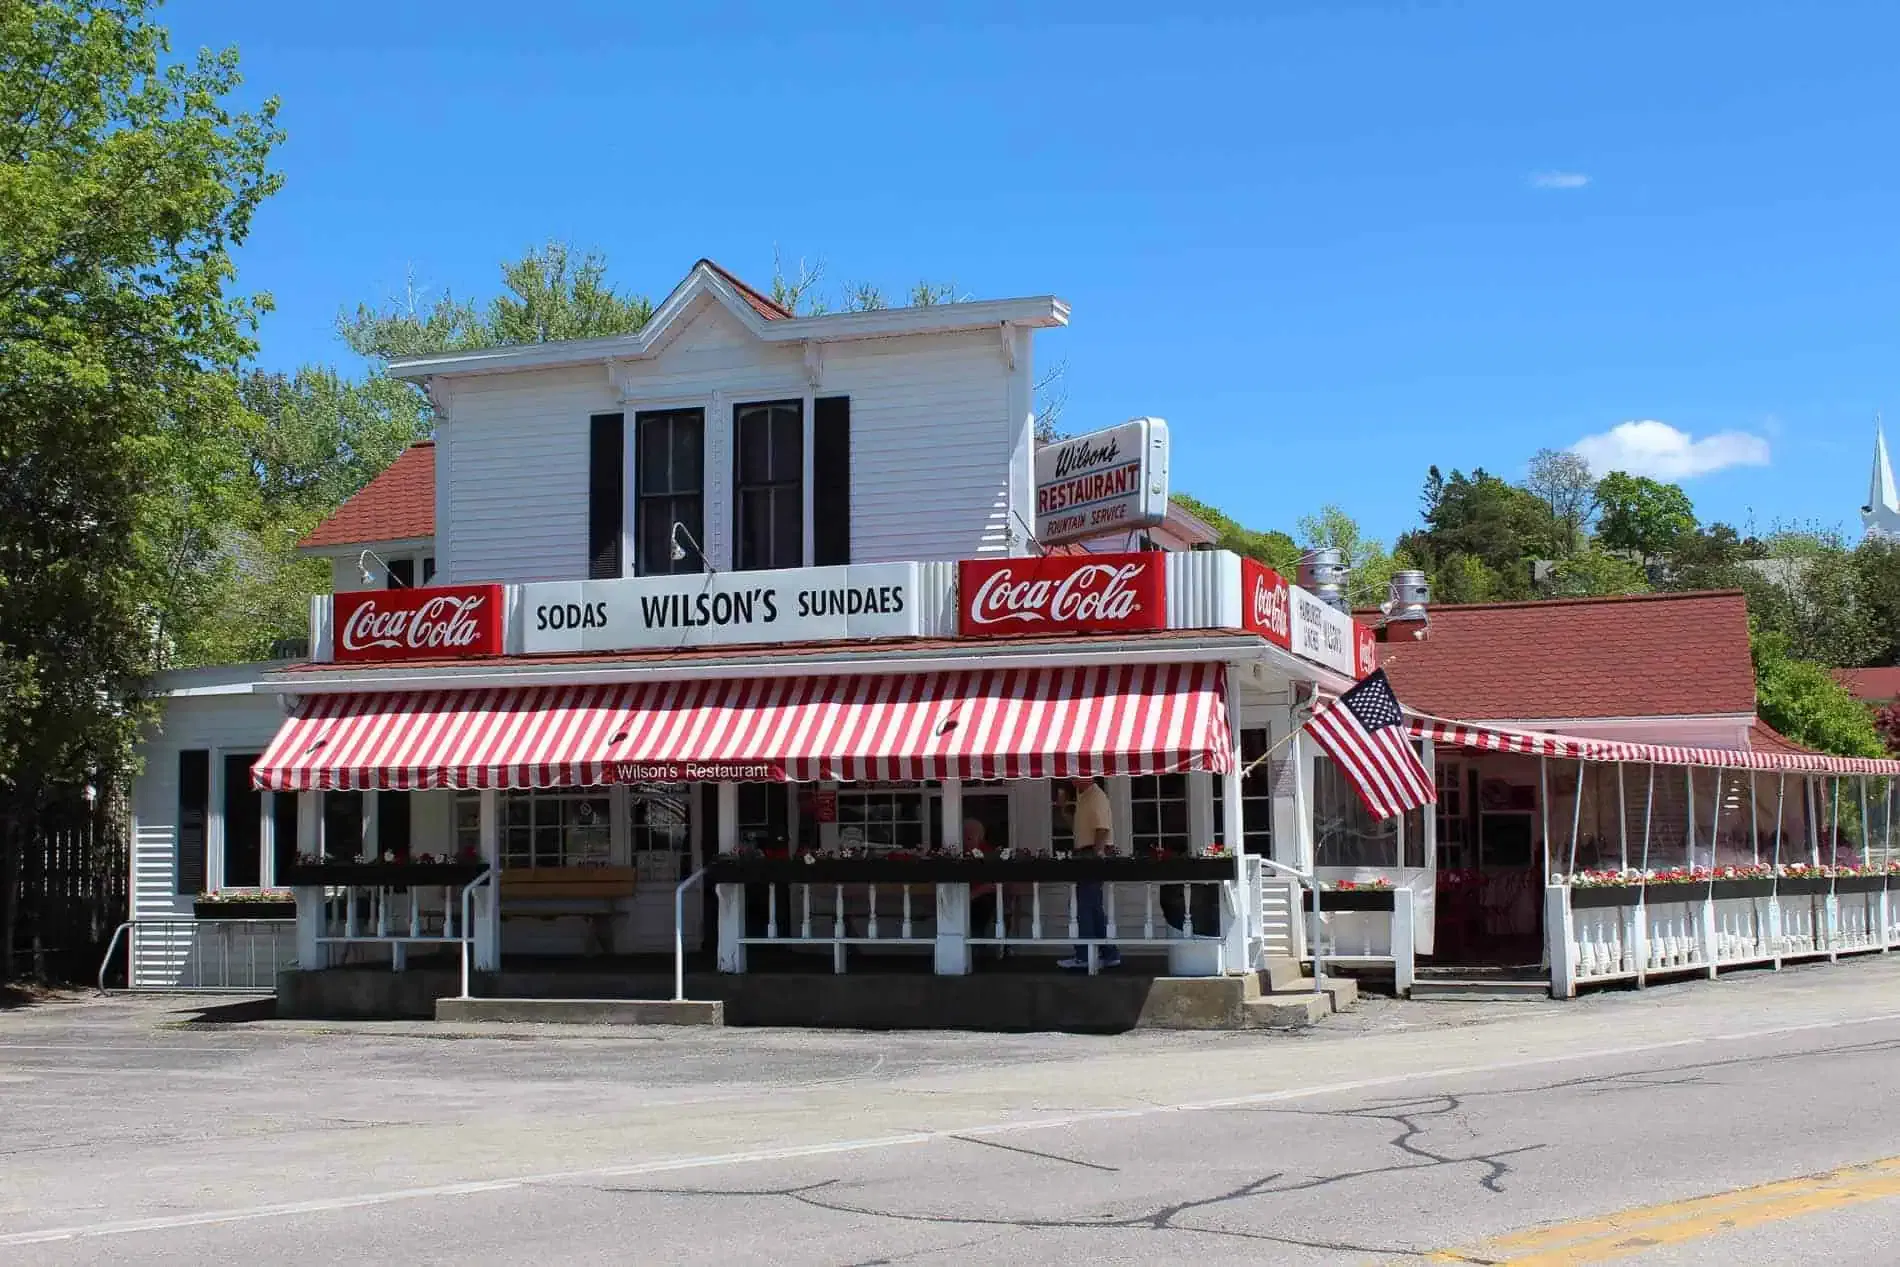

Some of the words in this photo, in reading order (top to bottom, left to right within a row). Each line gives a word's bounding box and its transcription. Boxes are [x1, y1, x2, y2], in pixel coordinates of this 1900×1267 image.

[1055, 436, 1120, 478] Wilson's
[1038, 464, 1139, 513] RESTAURANT
[1047, 514, 1086, 536] FOUNTAIN
[1091, 504, 1127, 525] SERVICE
[537, 602, 607, 631] SODAS
[641, 589, 778, 628] WILSON'S
[798, 586, 904, 617] SUNDAES
[972, 563, 1146, 624] Coca-Cola
[342, 595, 485, 650] Coca-Cola
[617, 764, 678, 779] Wilson's
[686, 763, 769, 778] Restaurant
